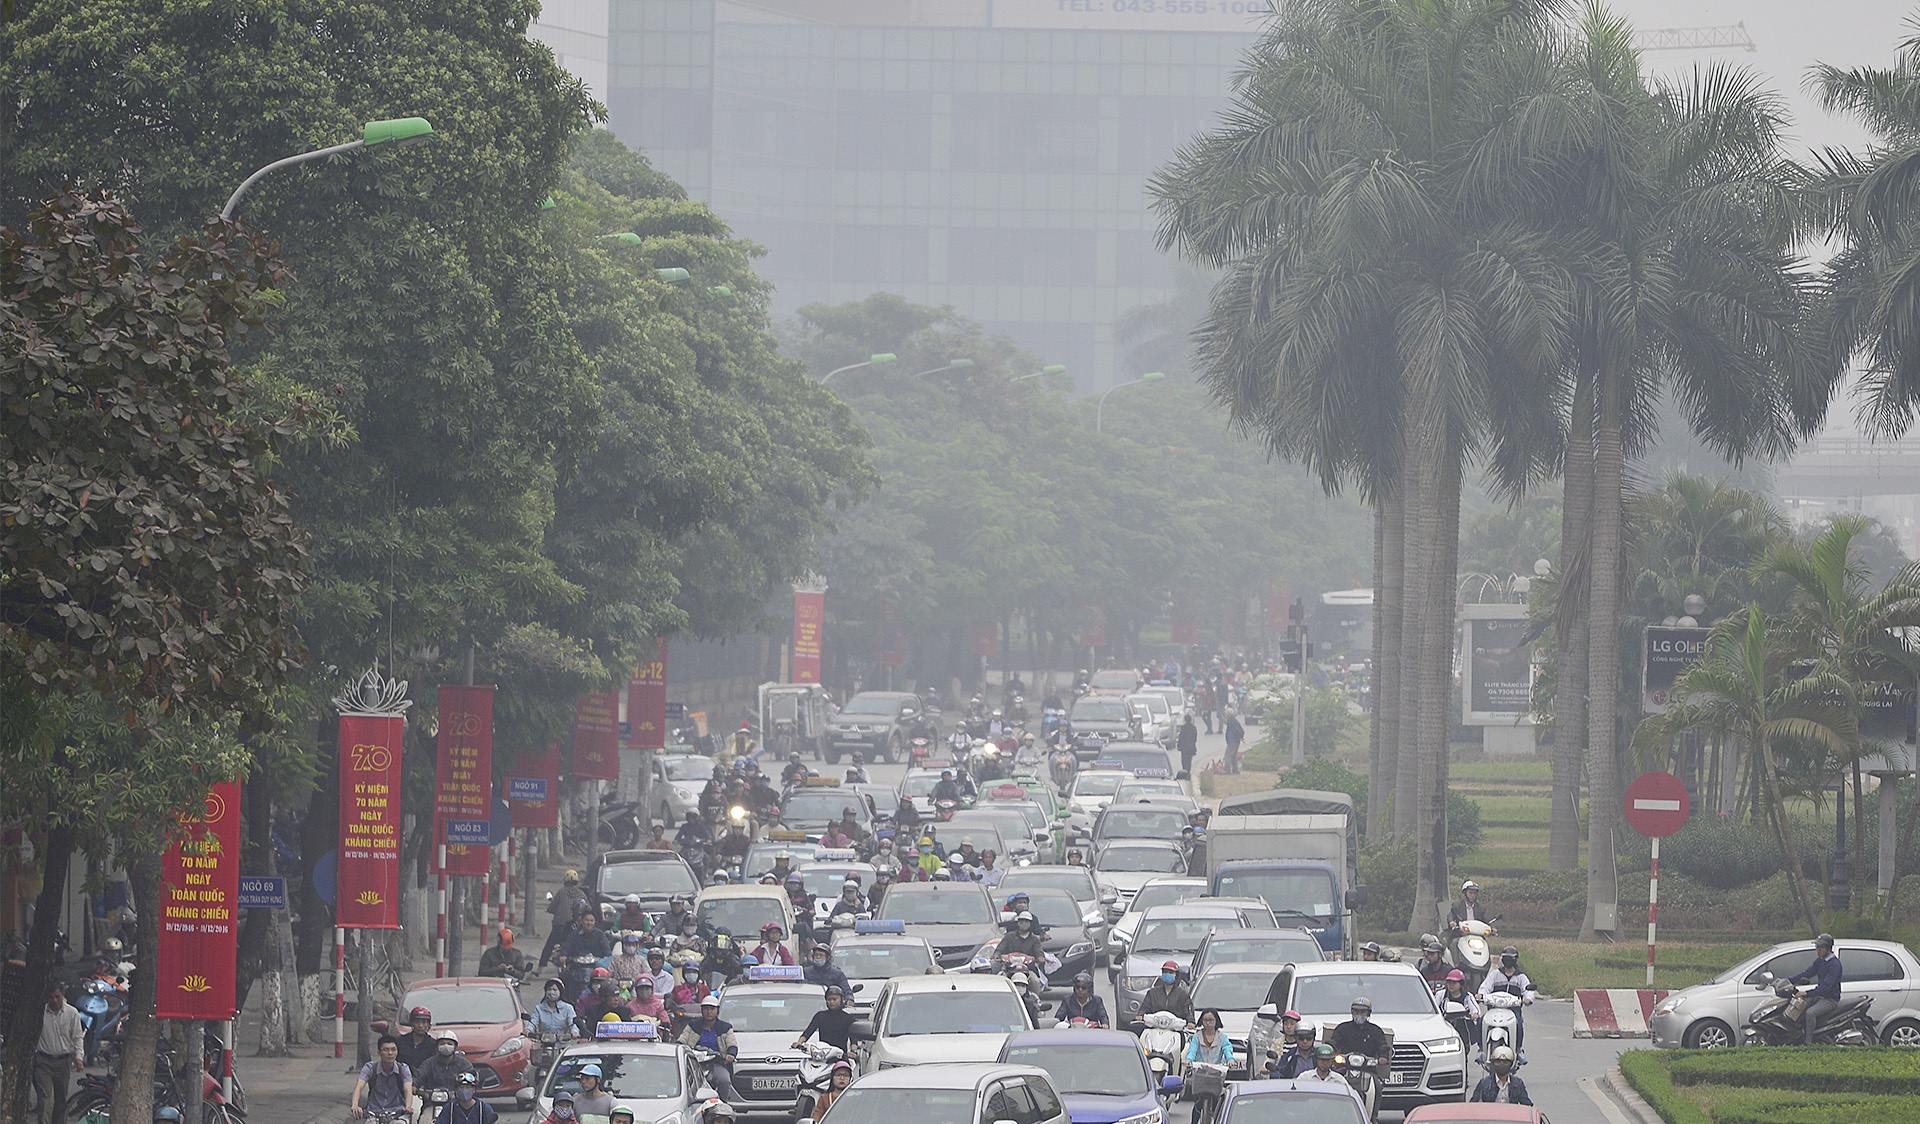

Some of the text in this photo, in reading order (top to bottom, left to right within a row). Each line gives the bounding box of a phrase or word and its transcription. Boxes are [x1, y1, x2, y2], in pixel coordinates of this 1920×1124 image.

[1112, 0, 1268, 14] 043-555-100
[1653, 640, 1670, 653] LG
[351, 744, 392, 771] 70
[367, 783, 389, 796] NIỆM
[356, 797, 387, 808] 70 NĂM
[360, 811, 382, 821] NGÀY
[349, 823, 394, 835] TOÀN QUỐC
[345, 836, 397, 849] KHÁNG CHIẾN
[181, 857, 192, 868] 70
[185, 871, 212, 885] NGÀY
[242, 880, 274, 892] NGÕ 69
[171, 887, 225, 902] TOÀN QUỐC
[166, 904, 229, 920] KHÁNG CHIẾN
[617, 1023, 636, 1034] SÔNG
